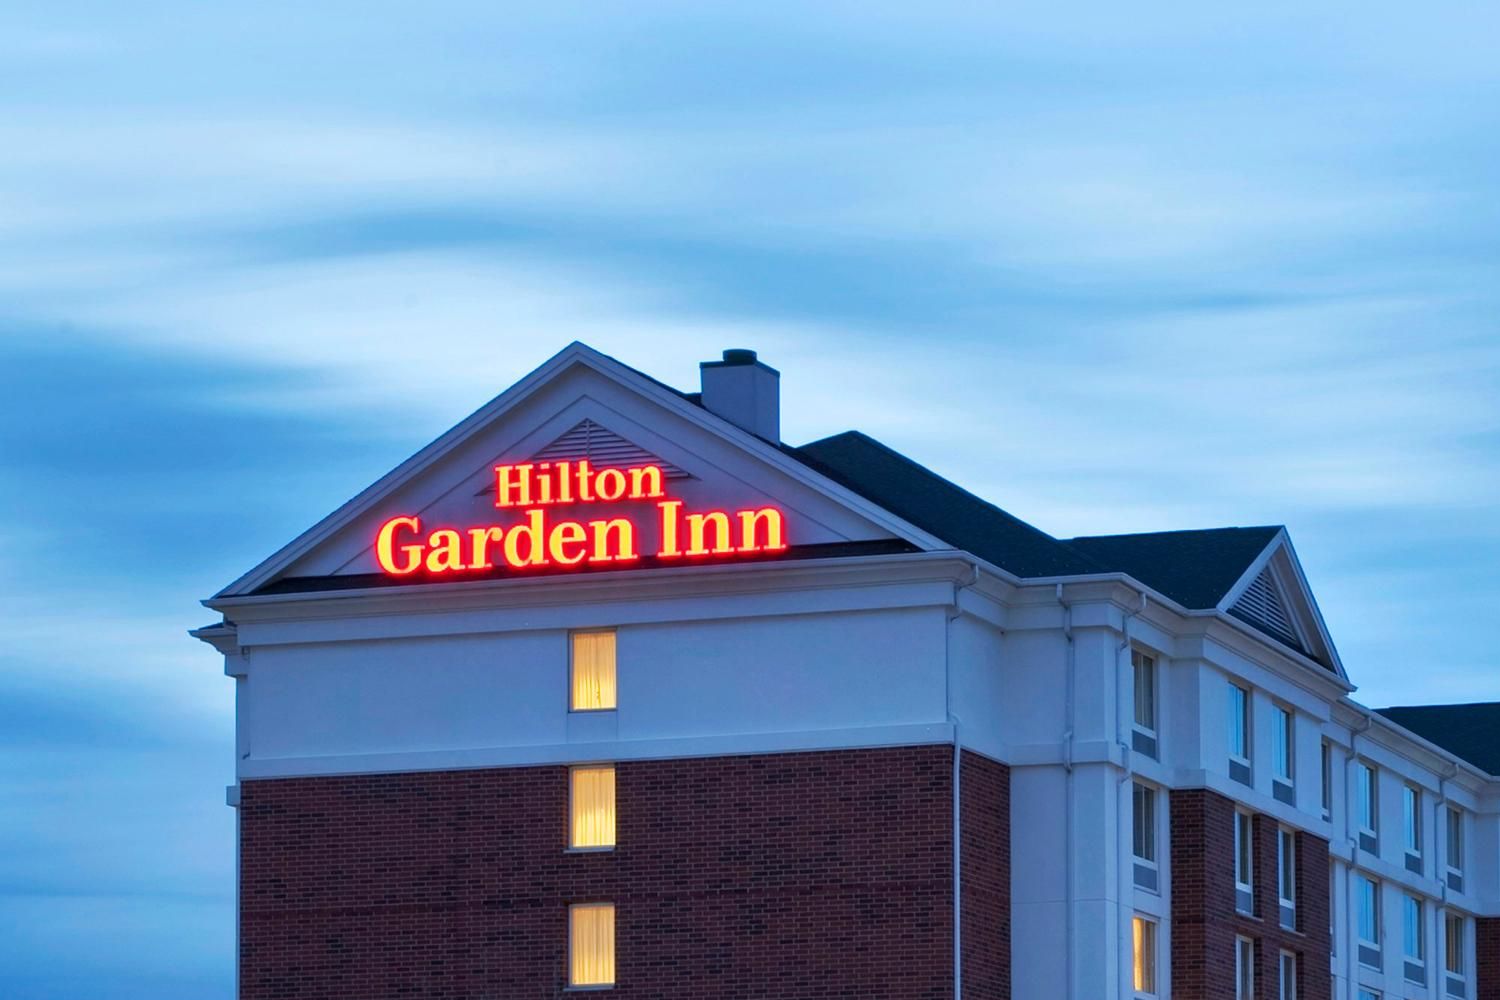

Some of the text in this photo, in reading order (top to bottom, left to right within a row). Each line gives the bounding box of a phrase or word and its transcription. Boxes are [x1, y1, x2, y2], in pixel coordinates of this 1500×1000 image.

[495, 459, 664, 508] Hilton
[376, 500, 788, 575] Garden Inn
